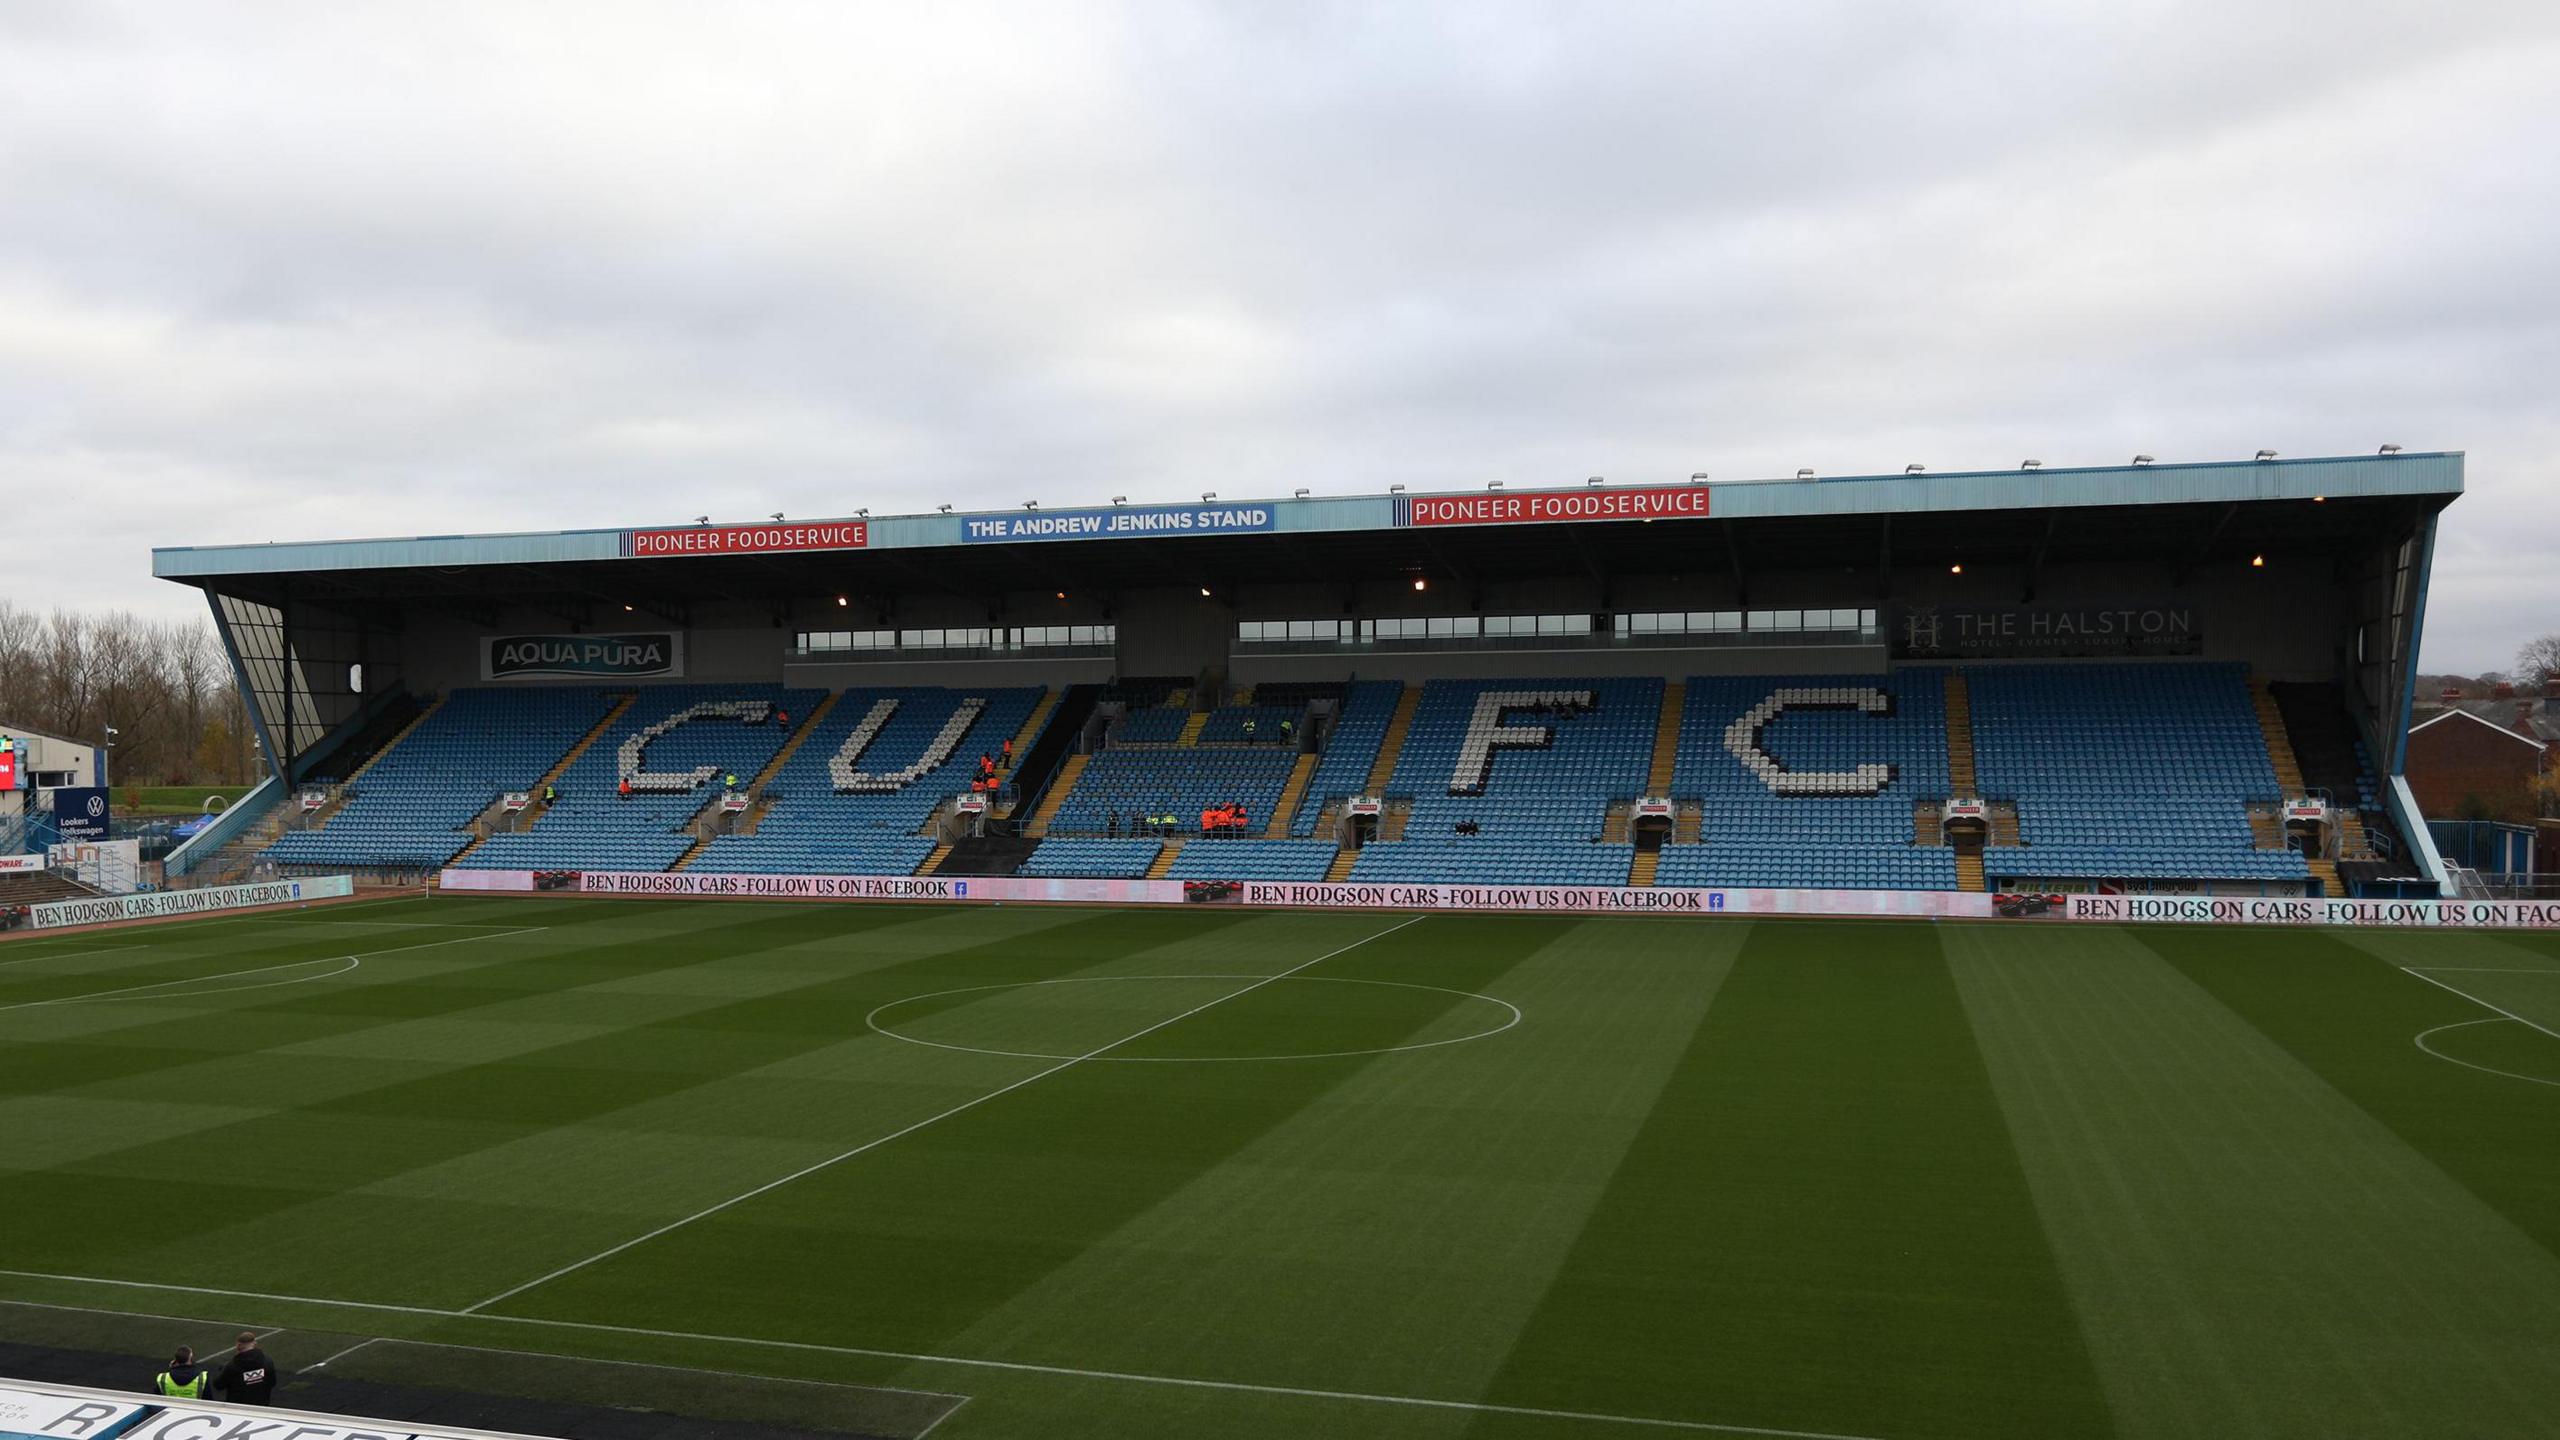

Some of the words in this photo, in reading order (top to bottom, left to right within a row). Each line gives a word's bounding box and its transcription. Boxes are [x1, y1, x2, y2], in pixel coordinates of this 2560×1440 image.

[1416, 500, 1520, 520] PIONEER
[1531, 493, 1704, 516] FOODSERVICE
[968, 521, 1007, 537] THE
[1011, 517, 1102, 536] ANDREW
[1106, 512, 1193, 532] JENKINS
[1198, 509, 1267, 528] STAND
[637, 533, 721, 552] PIONEER
[728, 526, 864, 548] FOODSERVICE
[1954, 613, 2016, 636] THE
[2031, 609, 2189, 634] HALSTON
[500, 643, 580, 665] AQUA
[584, 643, 663, 666] PURA
[60, 818, 89, 827] Lookers
[586, 875, 615, 889] BEN
[619, 876, 696, 891] HODGSON
[699, 877, 738, 891] CARS
[815, 879, 835, 893] US
[838, 879, 861, 893] ON
[865, 880, 949, 895] FACEBOOK
[1250, 885, 1287, 901] BEN
[1292, 886, 1385, 903] HODGSON
[1391, 888, 1439, 904] CARS
[1535, 890, 1559, 906] US
[1563, 890, 1594, 906] ON
[1597, 891, 1702, 908] FACEBOOK
[36, 906, 62, 924] BEN
[63, 901, 125, 921] HODGSON
[126, 897, 156, 915] CARS
[208, 891, 222, 906] US
[223, 889, 238, 904] ON
[239, 885, 291, 902] FACEBOOK
[2075, 899, 2120, 916] BEN
[2126, 900, 2244, 918] HODGSON
[2251, 902, 2312, 919] CARS
[2436, 904, 2466, 922] US
[2472, 904, 2509, 922] ON
